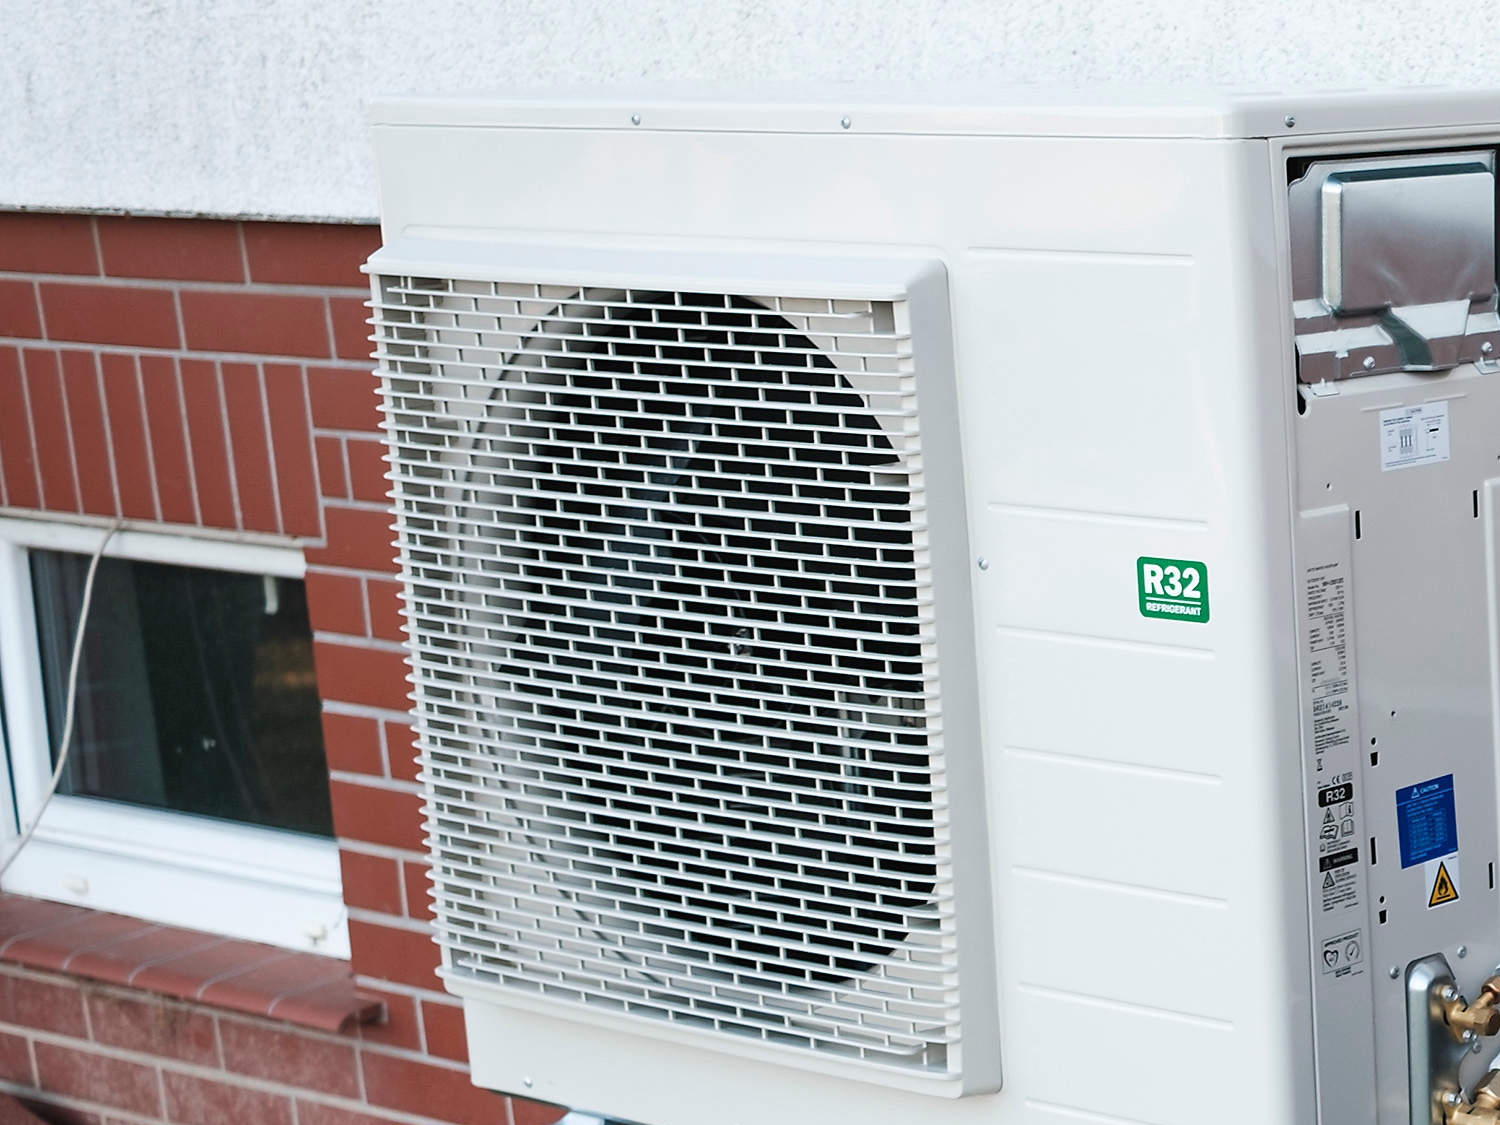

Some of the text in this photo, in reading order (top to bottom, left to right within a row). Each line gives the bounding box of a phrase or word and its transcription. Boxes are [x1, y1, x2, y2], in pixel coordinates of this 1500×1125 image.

[1143, 563, 1202, 599] R32
[1145, 601, 1202, 617] REFRIGERANT
[1325, 787, 1346, 803] R32
